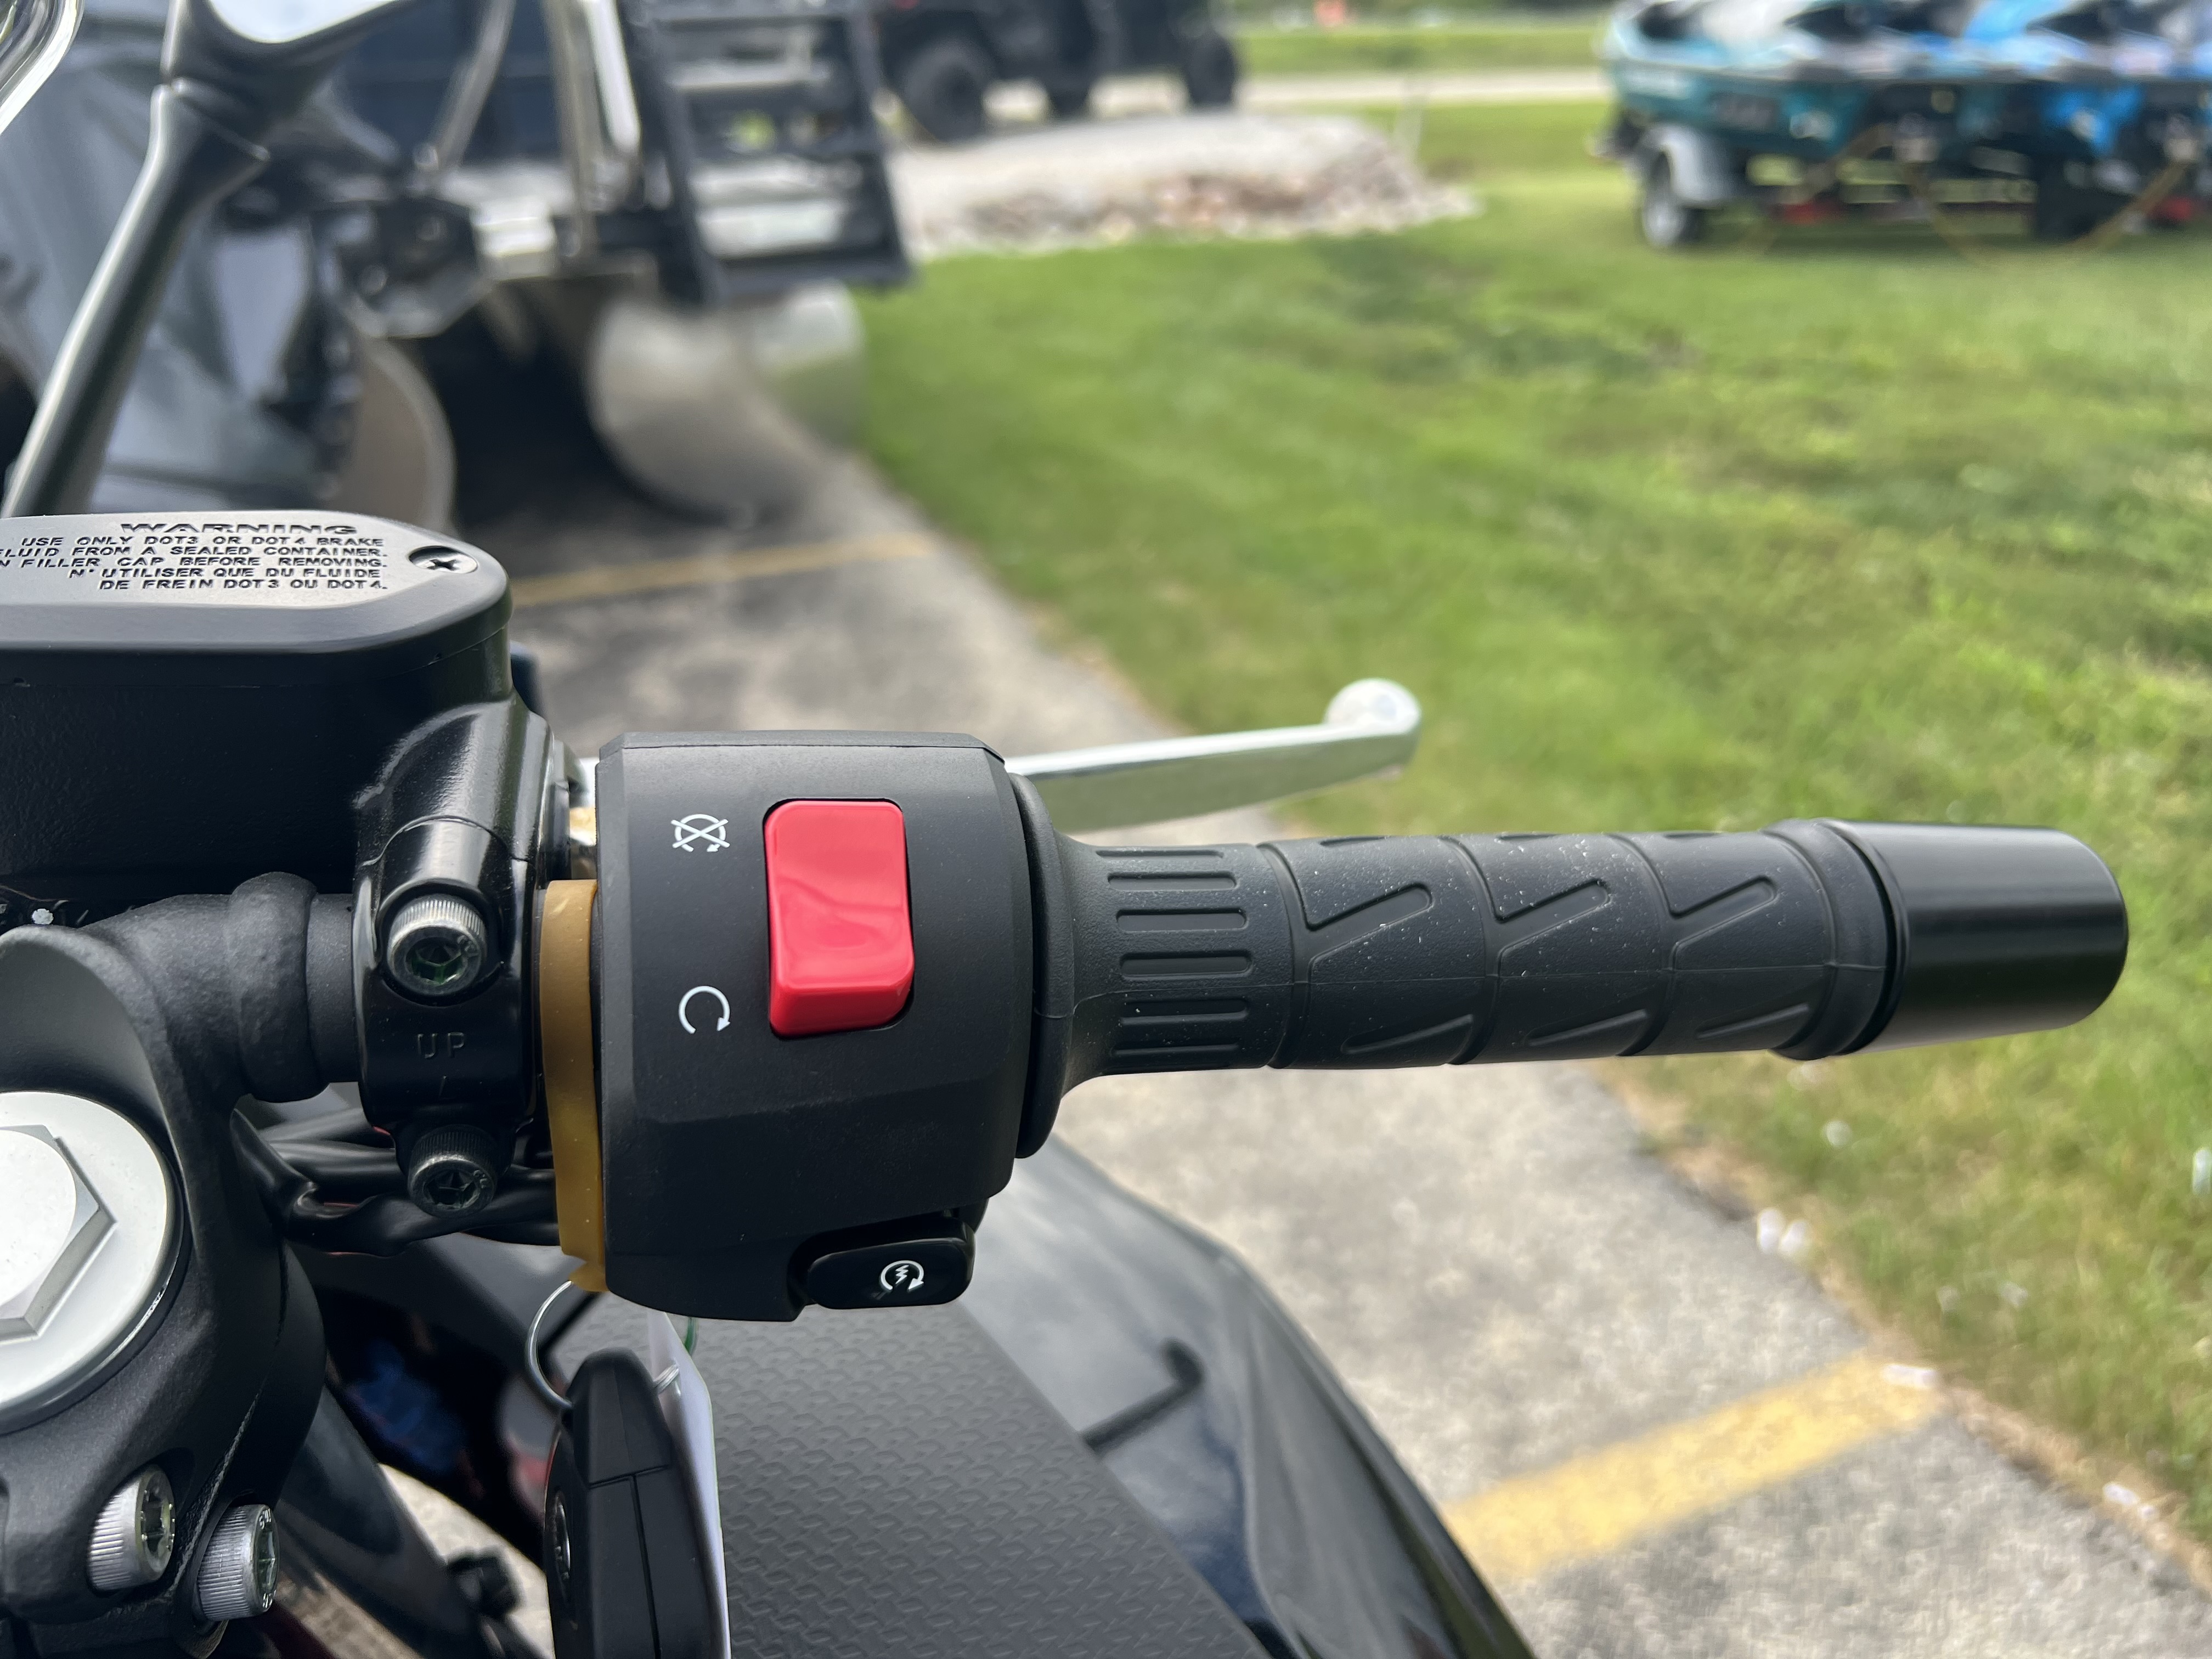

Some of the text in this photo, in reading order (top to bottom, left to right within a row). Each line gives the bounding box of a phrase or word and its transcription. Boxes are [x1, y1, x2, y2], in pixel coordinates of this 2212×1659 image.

[120, 523, 357, 534] WARNING
[21, 537, 64, 546] USE
[76, 536, 134, 545] ONLY
[144, 535, 199, 545] DOT3
[213, 536, 241, 545] OR
[317, 537, 383, 546] BRAKE
[72, 546, 131, 556] FROM
[140, 546, 156, 555] A
[170, 546, 252, 555] SEALED
[263, 546, 387, 556] CONTAINER.
[20, 558, 100, 568] FILLER
[117, 557, 165, 566] CAP
[179, 557, 261, 566] BEFORE
[278, 557, 387, 567] REMOVING.
[213, 568, 255, 577] QUE
[266, 568, 295, 577] DU
[303, 568, 381, 578] FLUIDE
[99, 579, 131, 590] DE
[142, 579, 214, 589] FREIN
[290, 579, 318, 589] OU
[417, 1032, 465, 1059] UP
